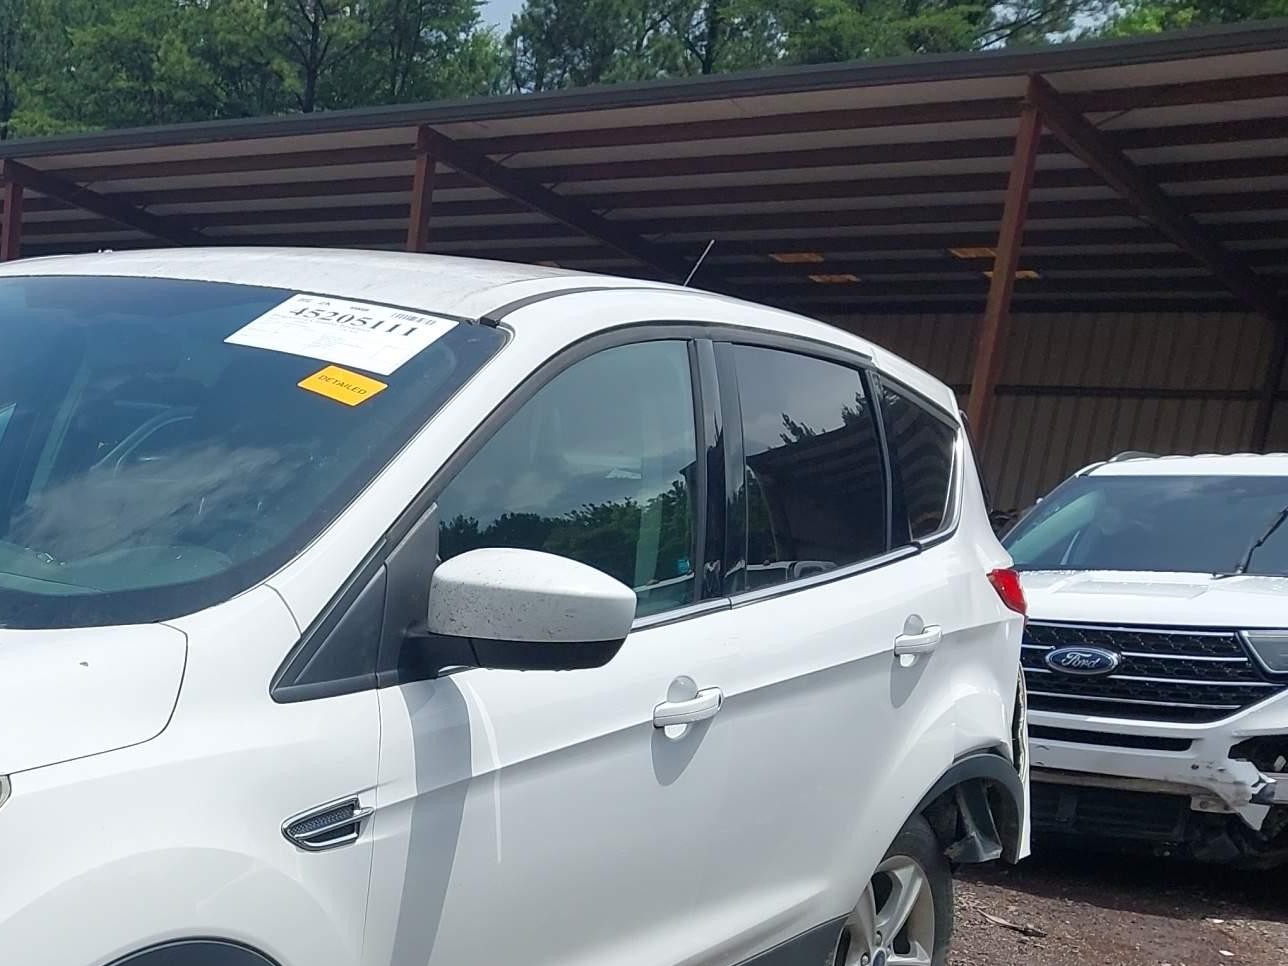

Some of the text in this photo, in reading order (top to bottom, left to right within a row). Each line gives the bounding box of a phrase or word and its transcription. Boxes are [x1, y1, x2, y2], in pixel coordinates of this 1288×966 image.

[289, 306, 418, 337] 45205111
[317, 374, 368, 395] DETAILED
[1061, 651, 1101, 669] Ford
